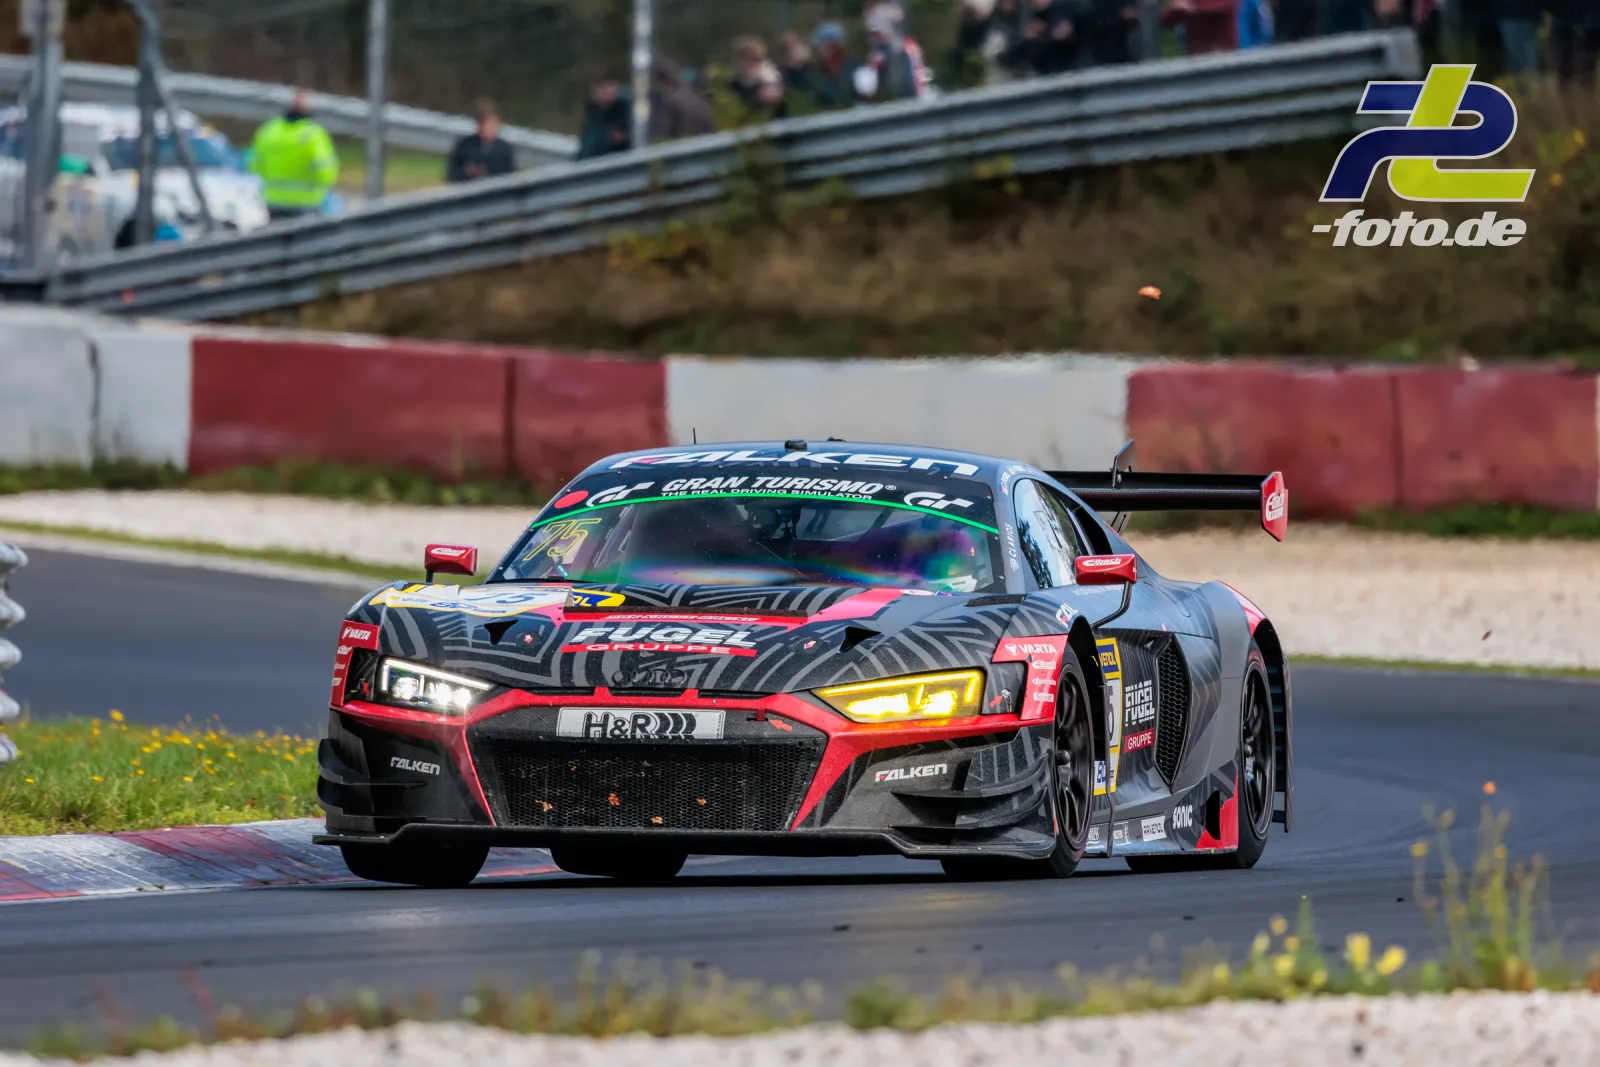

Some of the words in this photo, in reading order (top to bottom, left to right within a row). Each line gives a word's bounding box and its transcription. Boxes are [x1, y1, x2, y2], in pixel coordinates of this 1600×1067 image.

[609, 450, 979, 476] FALKEN
[661, 476, 749, 492] GRAN
[789, 489, 873, 500] SIMULATOR
[522, 517, 602, 561] 75
[570, 627, 757, 648] FUGEL
[586, 643, 731, 654] GRUPPE
[1018, 643, 1057, 654] VARTA
[583, 711, 653, 739] H&R
[1127, 731, 1152, 750] GRUPPE
[390, 756, 441, 776] FALKEN
[875, 763, 948, 783] FALKEN
